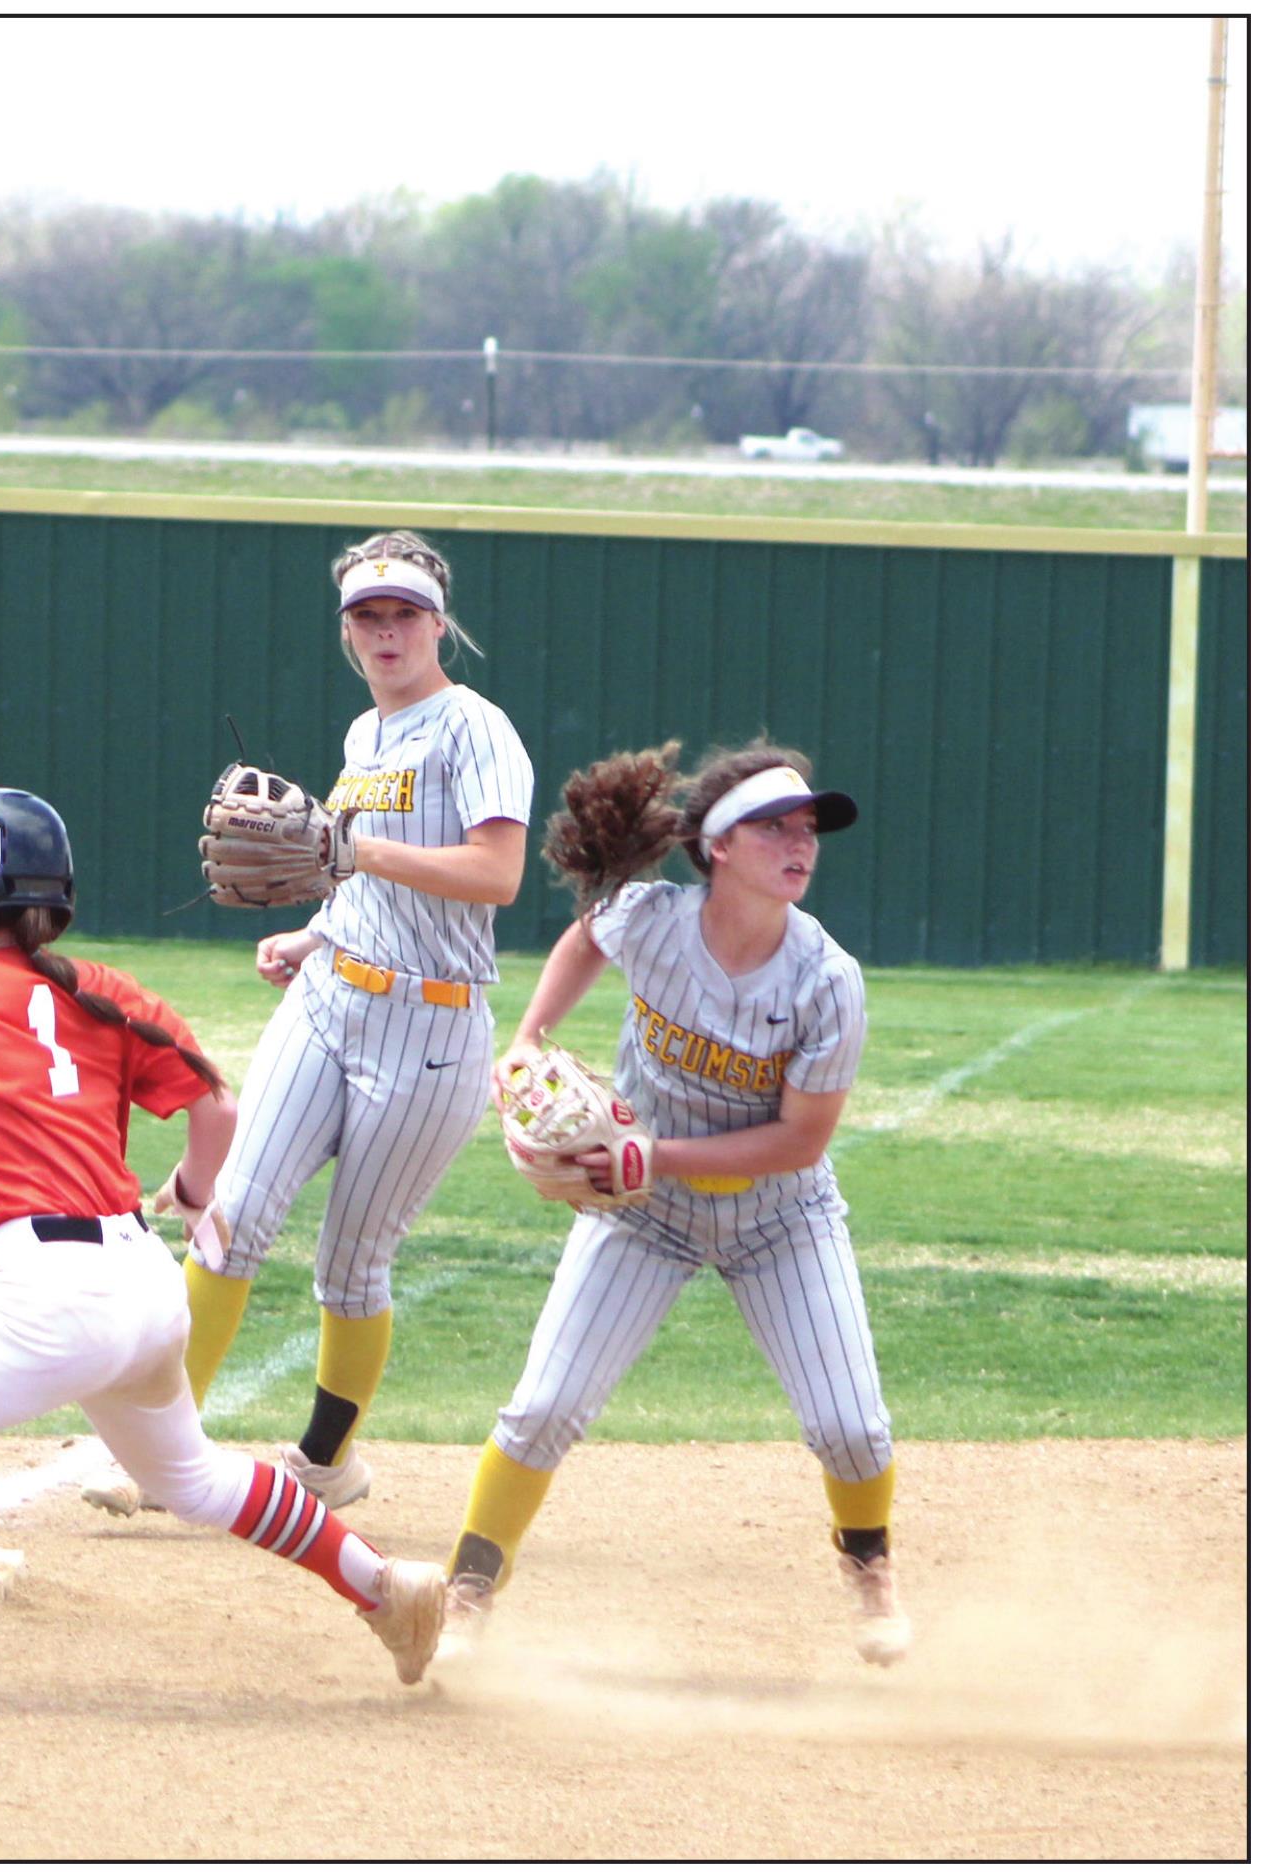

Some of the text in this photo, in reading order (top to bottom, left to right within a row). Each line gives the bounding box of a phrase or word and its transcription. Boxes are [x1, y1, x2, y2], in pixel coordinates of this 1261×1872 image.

[374, 562, 389, 577] T
[324, 768, 416, 813] CUMSEH
[228, 815, 275, 833] marucci
[27, 984, 79, 1097] 1
